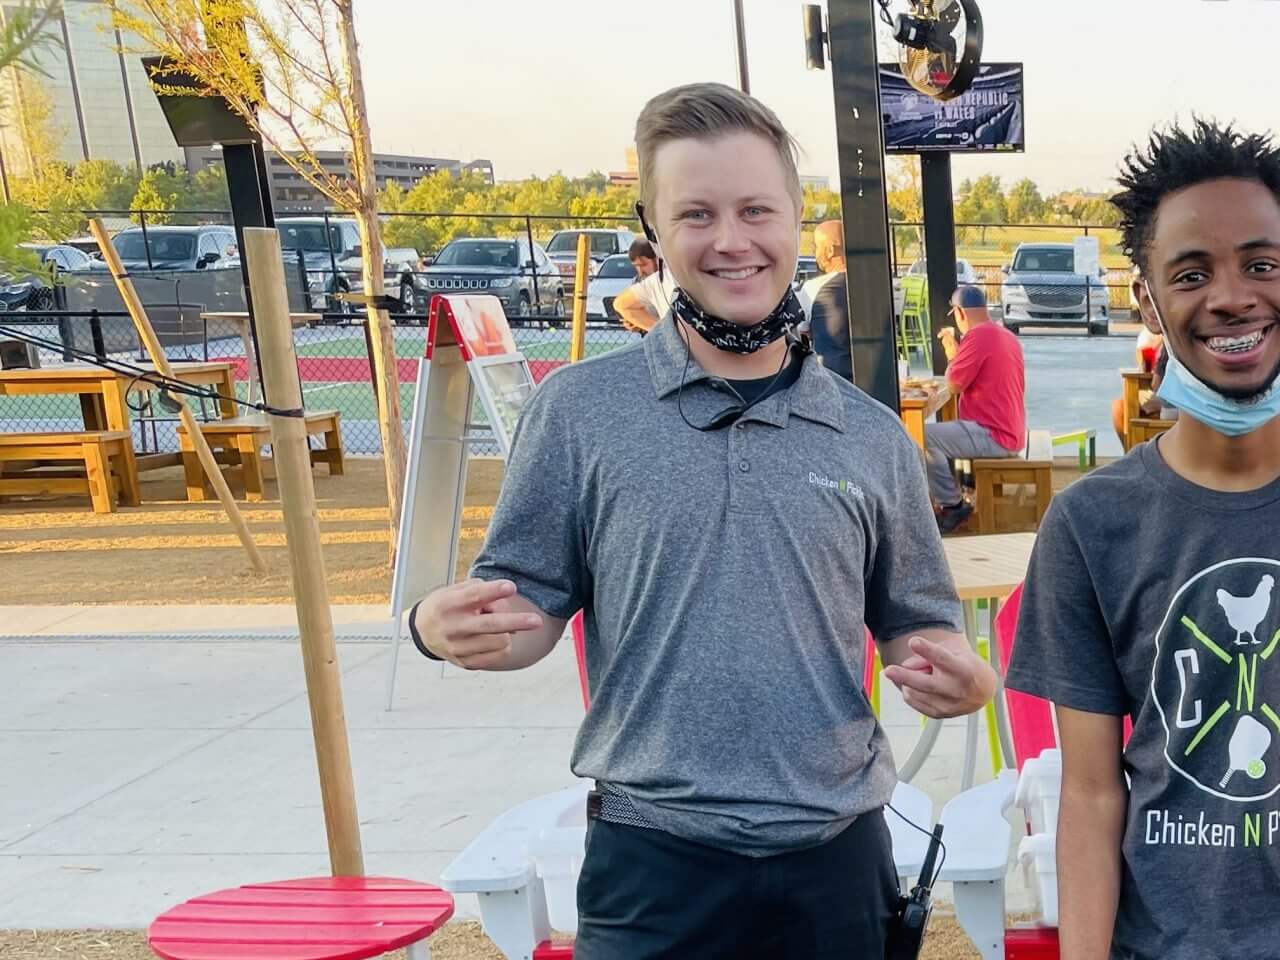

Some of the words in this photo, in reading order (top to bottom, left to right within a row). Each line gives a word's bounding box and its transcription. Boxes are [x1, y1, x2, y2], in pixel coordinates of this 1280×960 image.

[945, 106, 975, 120] WALES
[1173, 647, 1203, 729] C
[1145, 808, 1236, 848] Chicken
[1243, 812, 1261, 847] N
